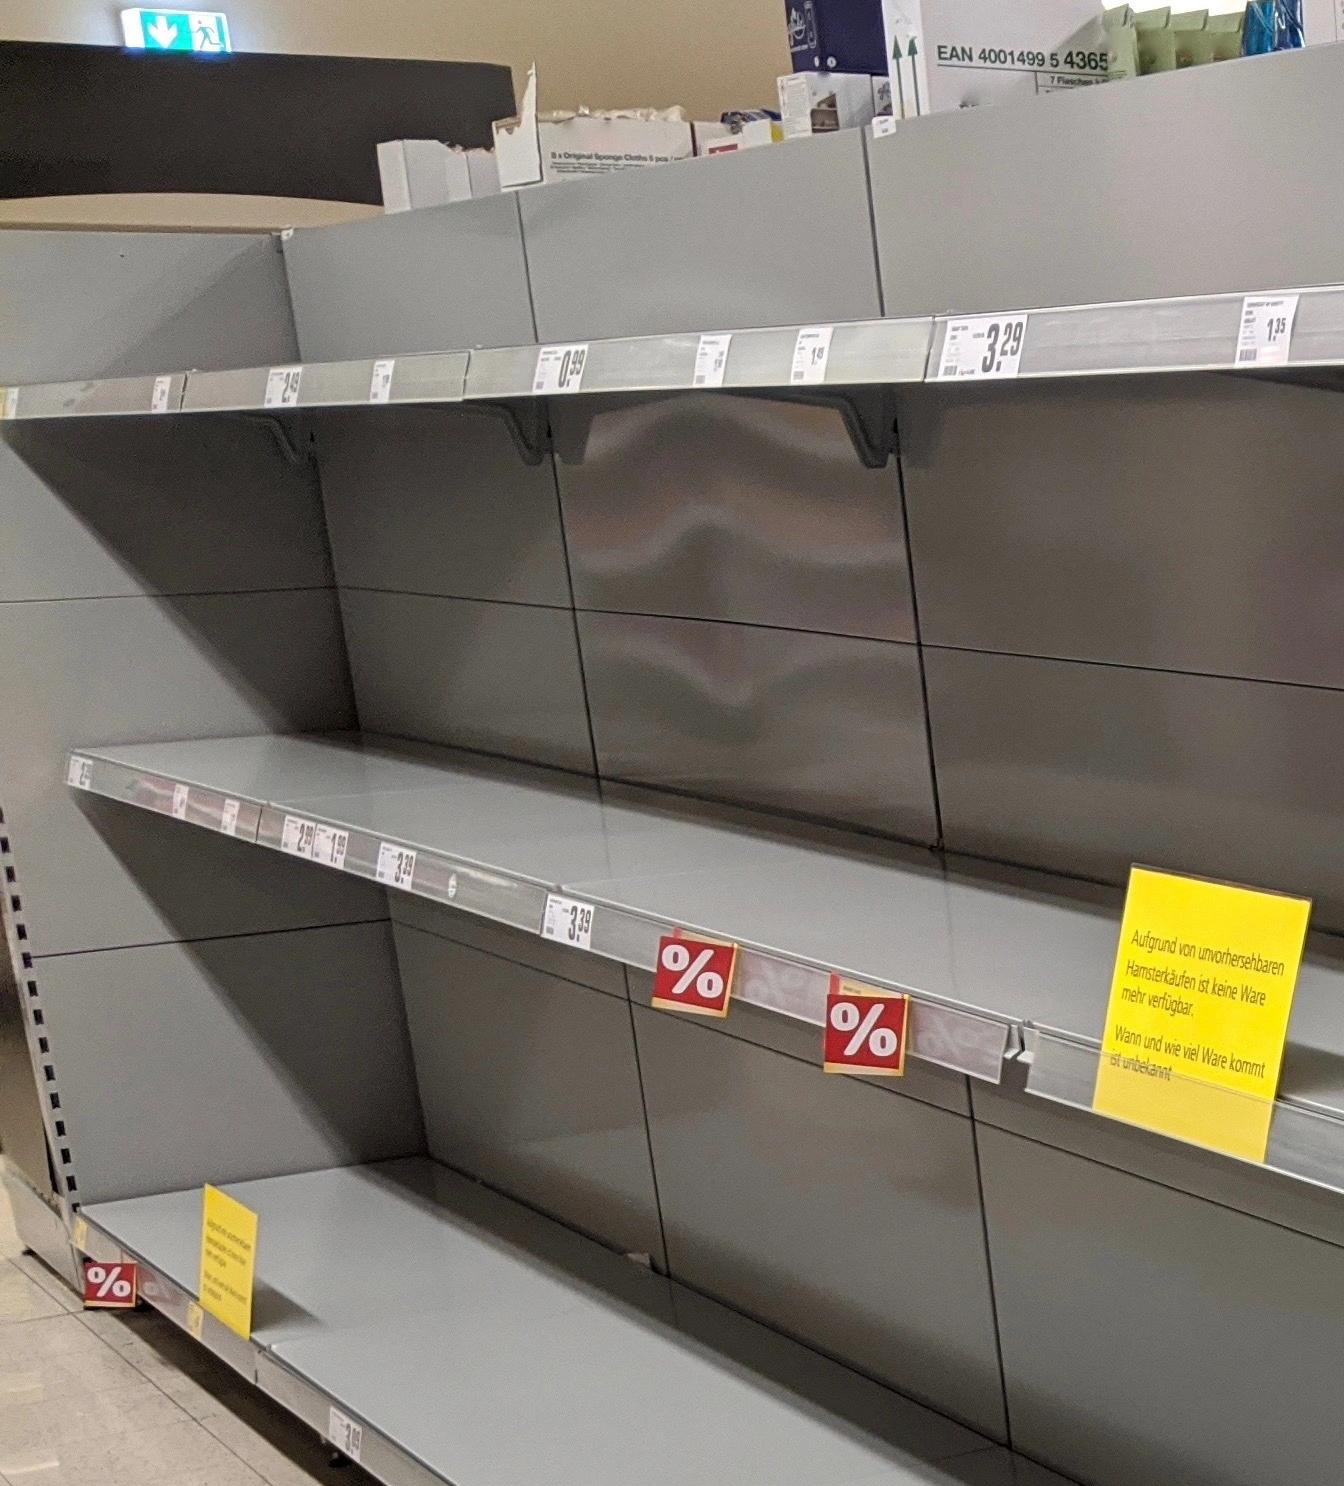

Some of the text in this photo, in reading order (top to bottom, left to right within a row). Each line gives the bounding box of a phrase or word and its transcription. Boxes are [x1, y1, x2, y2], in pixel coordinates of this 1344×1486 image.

[937, 45, 1109, 71] EAN 4001499 5 4365
[563, 152, 592, 160] Original
[595, 152, 623, 162] Sponge
[981, 322, 1024, 373] 3.29
[1267, 317, 1287, 342] 1.35
[558, 350, 586, 387] 0.99
[568, 905, 592, 942] 3.39
[1131, 929, 1285, 976] Aufgrund von unvorhersehbaren
[661, 944, 724, 999] %
[1125, 959, 1266, 1006] Hamsterkäufen ist keine Ware
[1121, 986, 1194, 1016] mehr verfügbar.
[830, 1002, 898, 1057] %
[1110, 1048, 1172, 1081] ist unbekannt
[1115, 1024, 1265, 1079] Wann und wie viel Ware kommt
[87, 1266, 131, 1297] %
